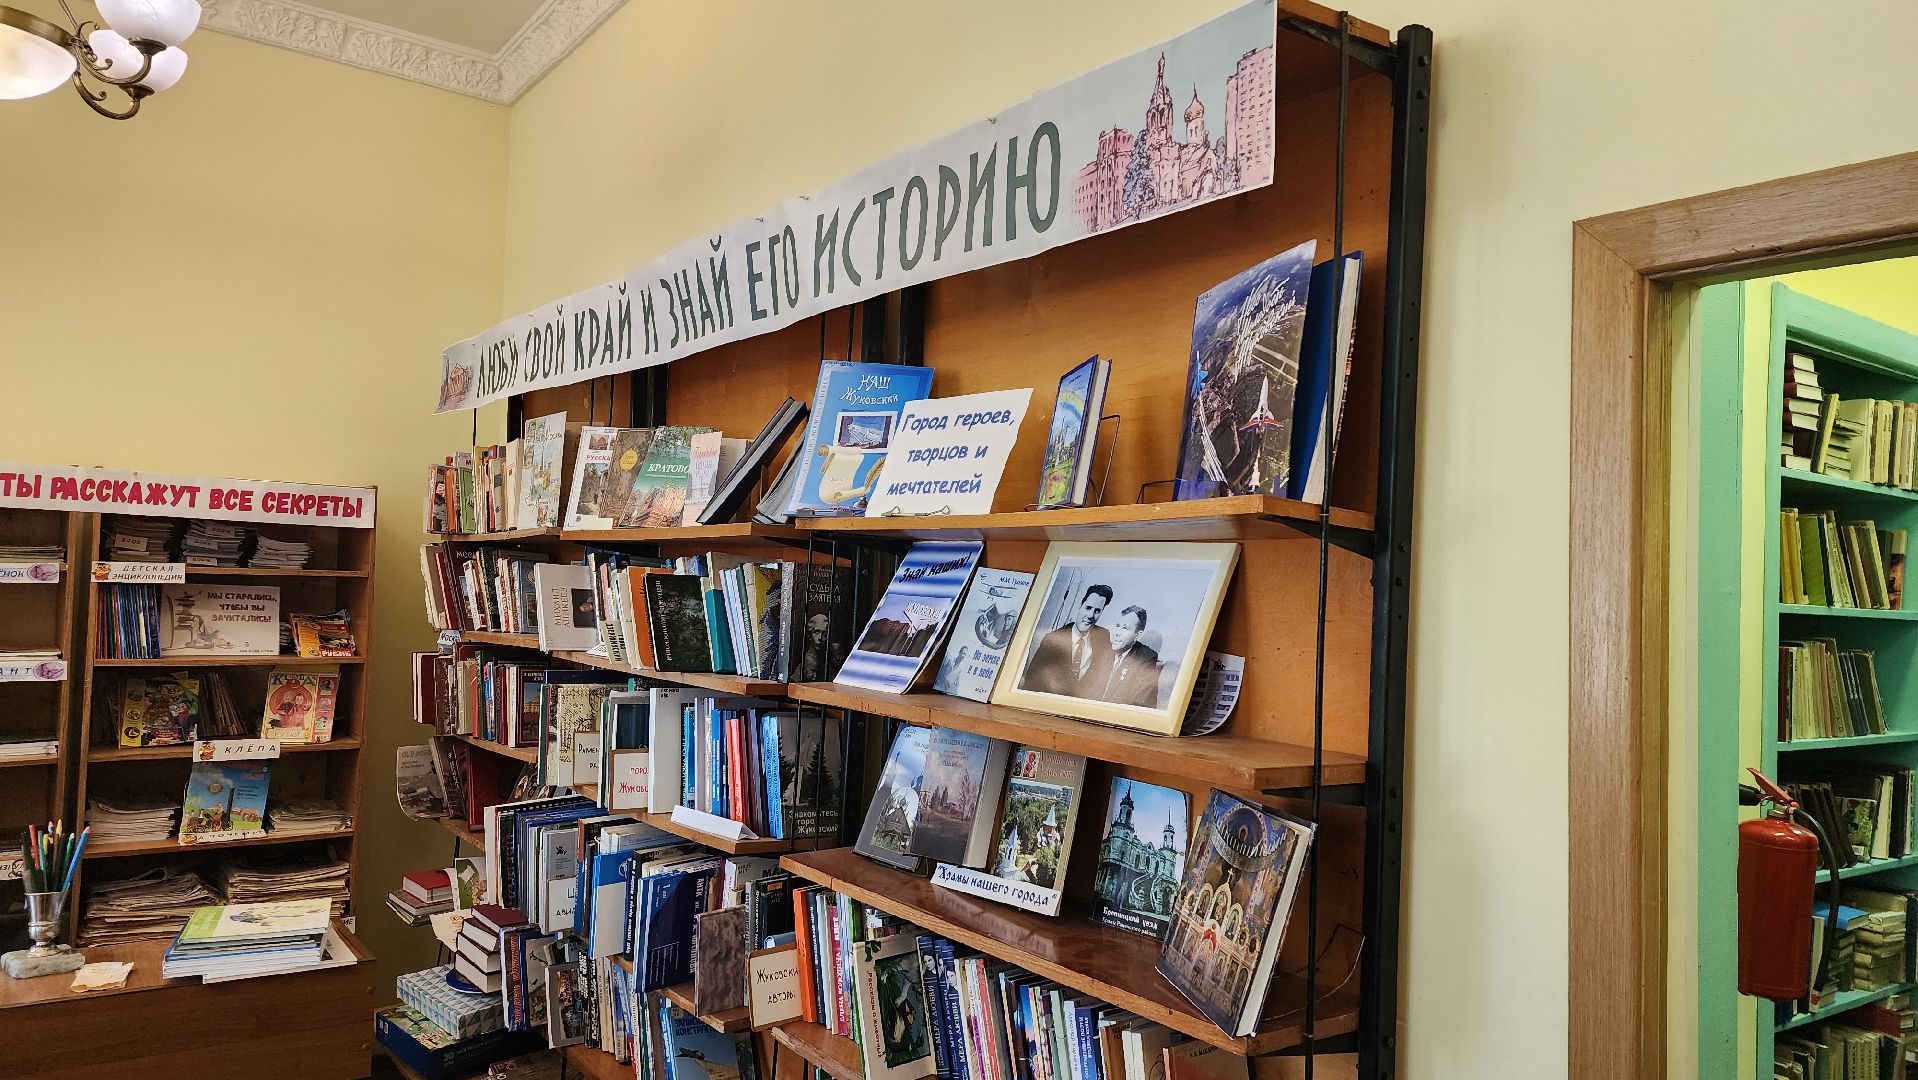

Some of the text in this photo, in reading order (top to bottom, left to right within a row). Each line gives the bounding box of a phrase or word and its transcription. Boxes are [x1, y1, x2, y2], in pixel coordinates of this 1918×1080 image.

[477, 121, 1061, 398] ЛЮБИ СВОЙ КРАЙ И ЗНАЙ ЕГО ИСТОРИЮ
[857, 374, 891, 392] НАШ
[901, 409, 1016, 435] Город героев,
[907, 445, 989, 467] творцов и
[887, 473, 983, 496] мечтателей
[0, 472, 363, 519] ТЫ РАССКАЖУТ ВСЕ СЕКРЕТЫ
[0, 568, 25, 578] ЁНОК
[122, 565, 174, 573] ДЕТСКАЯ
[899, 552, 973, 584] Знай наших!
[207, 592, 223, 600] МЫ
[810, 583, 840, 594] СУДЬА
[219, 603, 266, 612] ЧТОБЫ ВЫ
[211, 614, 272, 623] ЗАЧИТАЛИСЬ!
[224, 744, 277, 754] КЛЁПА
[789, 810, 839, 819] Знакомтесь
[970, 877, 1009, 896] нашего
[756, 967, 799, 985] ЖУКОВСКИ
[928, 984, 943, 1045] МЕРА ЛЮБВИ
